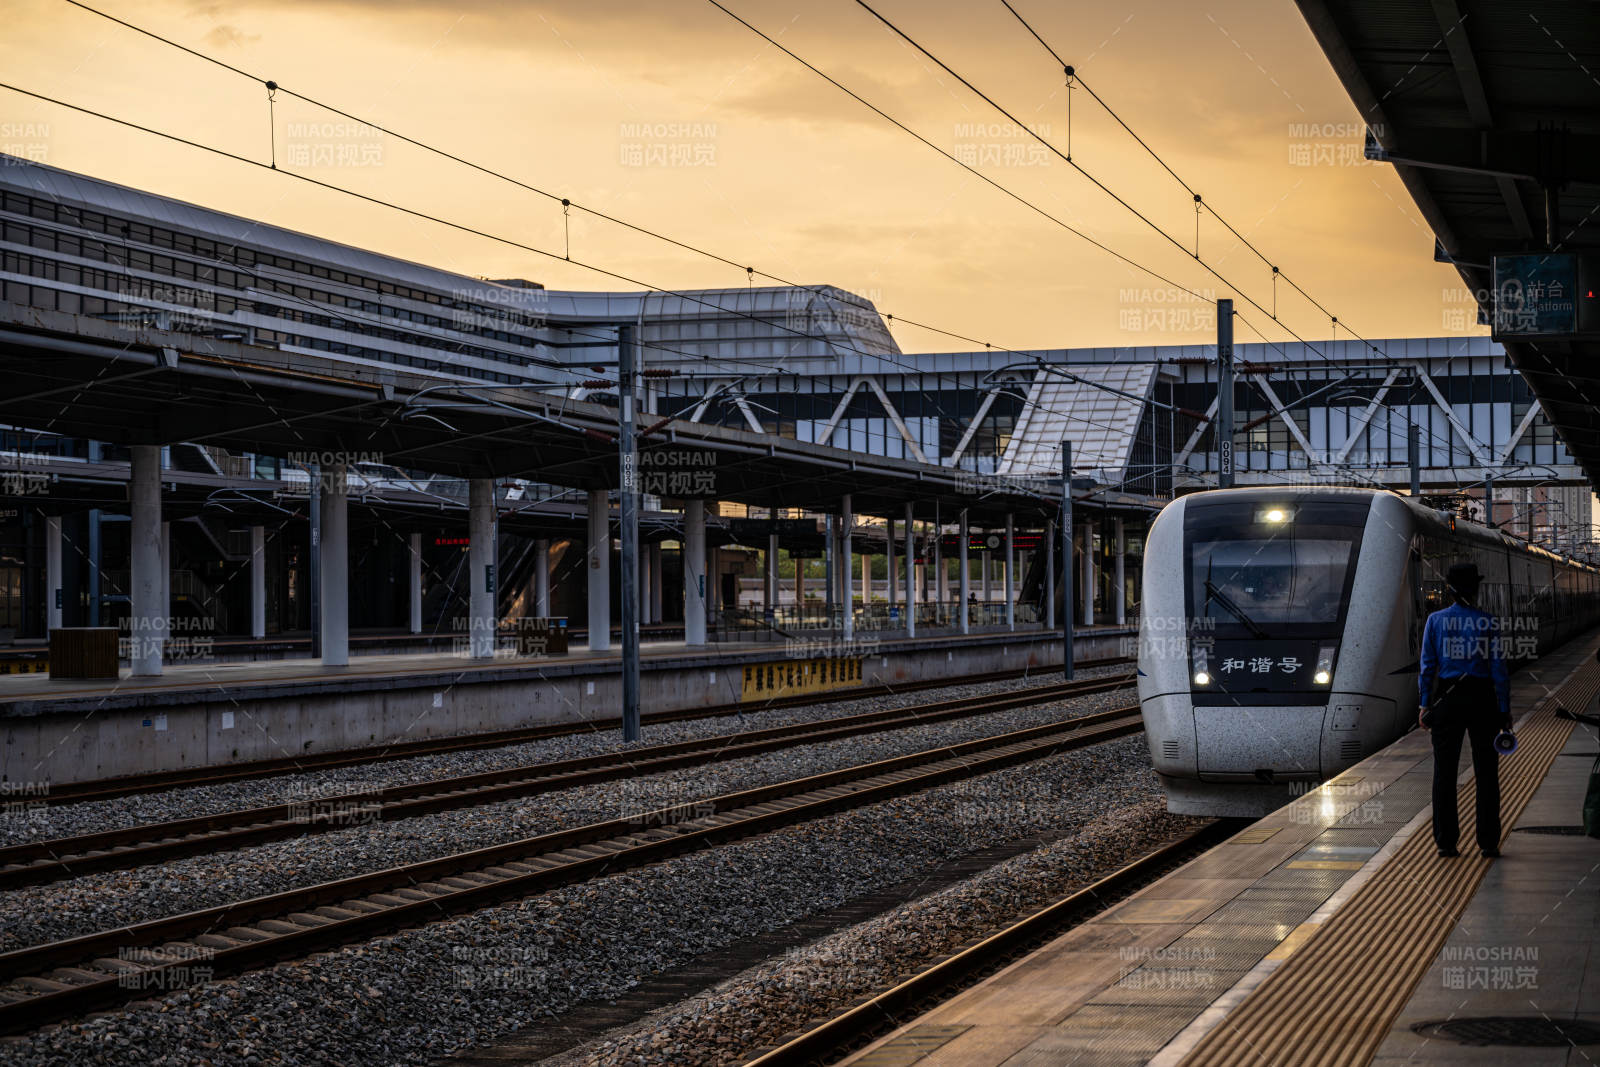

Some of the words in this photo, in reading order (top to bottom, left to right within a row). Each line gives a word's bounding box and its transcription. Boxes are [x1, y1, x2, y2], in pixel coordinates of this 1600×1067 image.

[1527, 280, 1563, 299] 站台
[1527, 302, 1573, 312] Platform
[1220, 657, 1303, 674] 和谐号
